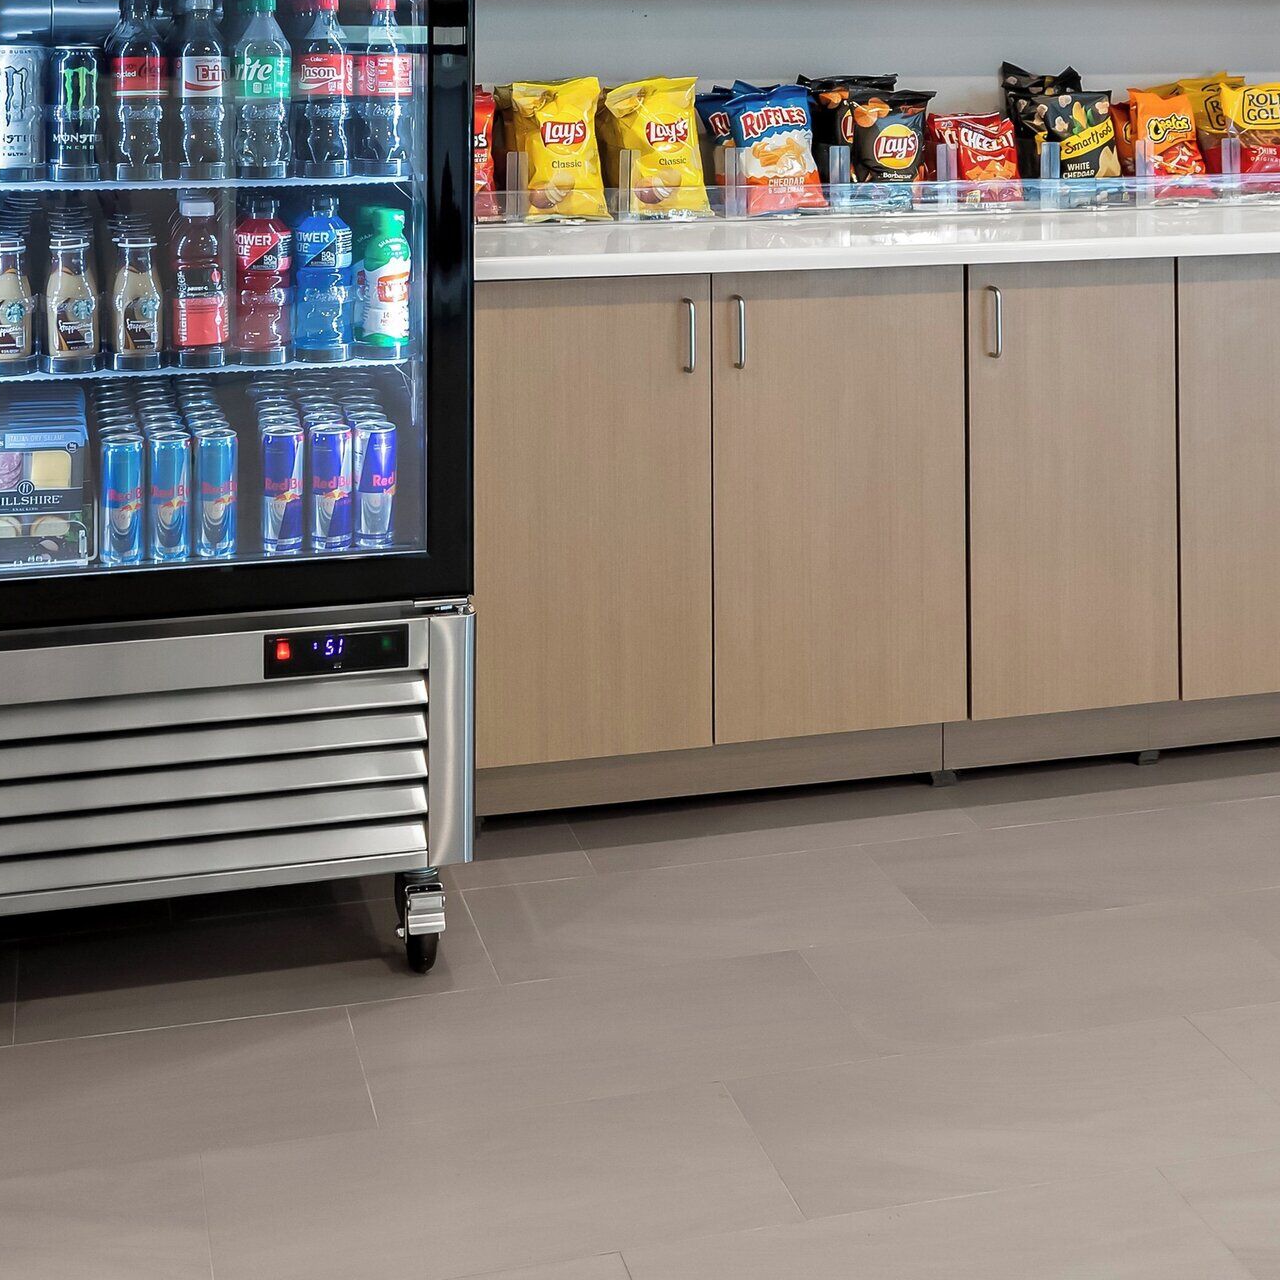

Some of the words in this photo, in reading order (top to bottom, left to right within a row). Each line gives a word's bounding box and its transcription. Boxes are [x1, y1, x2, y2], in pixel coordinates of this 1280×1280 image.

[235, 57, 273, 81] rite
[301, 64, 336, 81] Jason
[740, 106, 807, 139] RUFFLES
[1147, 115, 1193, 144] Cheetos
[543, 120, 586, 145] Lay's
[648, 120, 688, 145] Lay's
[1063, 124, 1114, 155] Smartfood
[876, 134, 918, 160] Lay's
[1257, 147, 1278, 156] THINS
[551, 159, 583, 169] Classic
[658, 157, 687, 166] Classic
[1067, 161, 1091, 171] WHITE
[768, 176, 805, 188] CHEDDAR
[882, 171, 913, 180] Barbecue
[1062, 169, 1095, 180] CHEDDAR
[372, 474, 395, 487] Red
